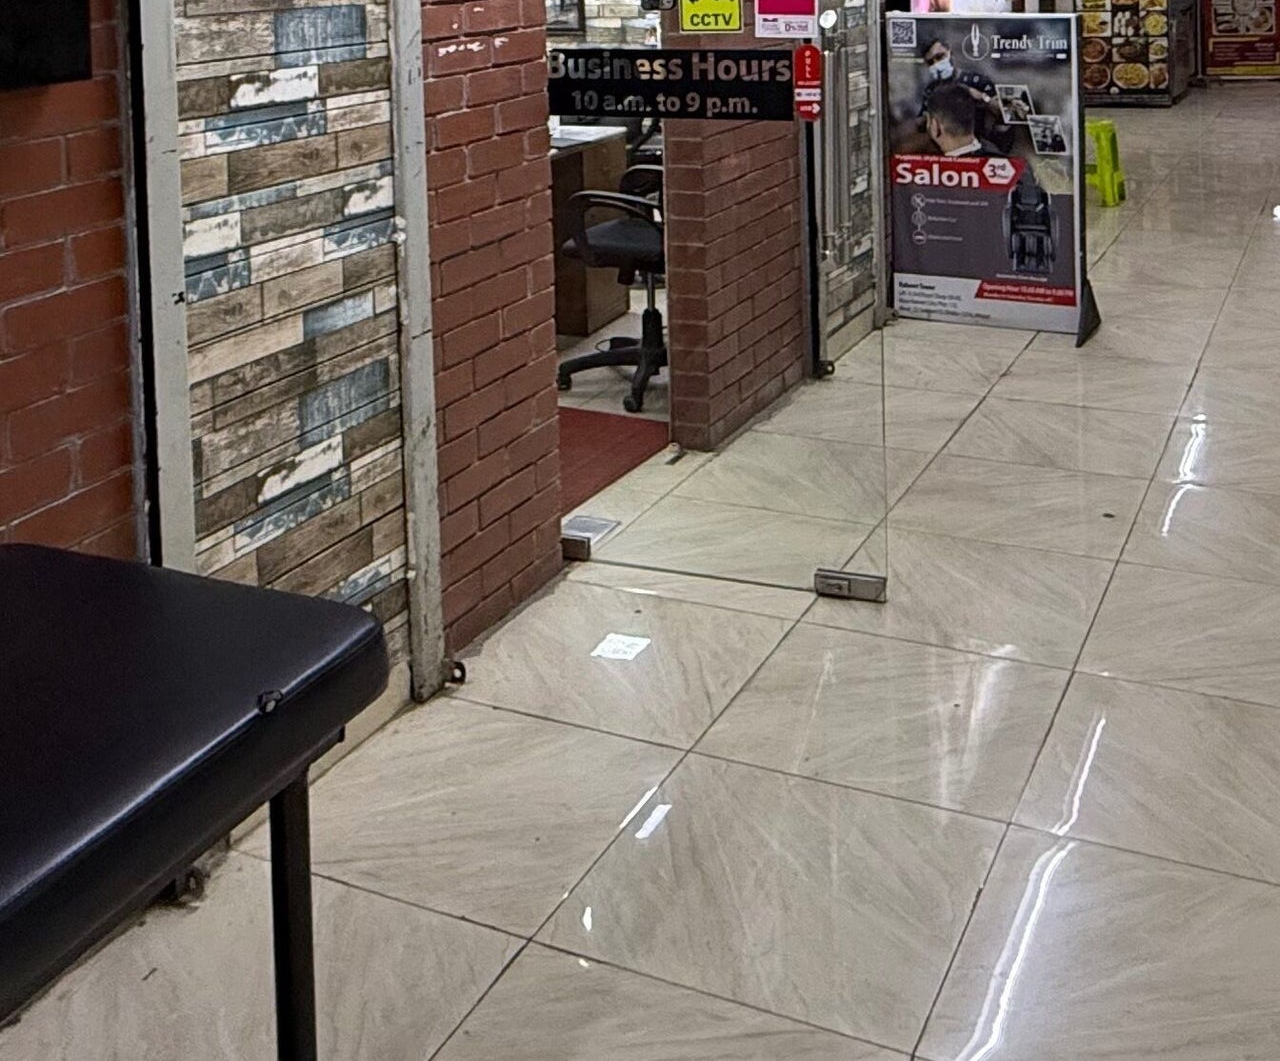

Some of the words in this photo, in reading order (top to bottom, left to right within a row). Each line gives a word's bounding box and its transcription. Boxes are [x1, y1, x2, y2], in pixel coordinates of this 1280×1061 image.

[690, 13, 733, 27] CCTV
[990, 34, 1033, 52] Trendy
[1037, 35, 1068, 50] Trim
[548, 51, 684, 81] Business
[691, 51, 792, 82] Hours
[571, 90, 599, 111] 10
[602, 94, 653, 113] a.m.
[656, 92, 682, 112] to
[685, 91, 701, 113] 9
[706, 95, 759, 118] p.m.
[895, 163, 980, 188] Salon
[987, 163, 1007, 179] 3rd
